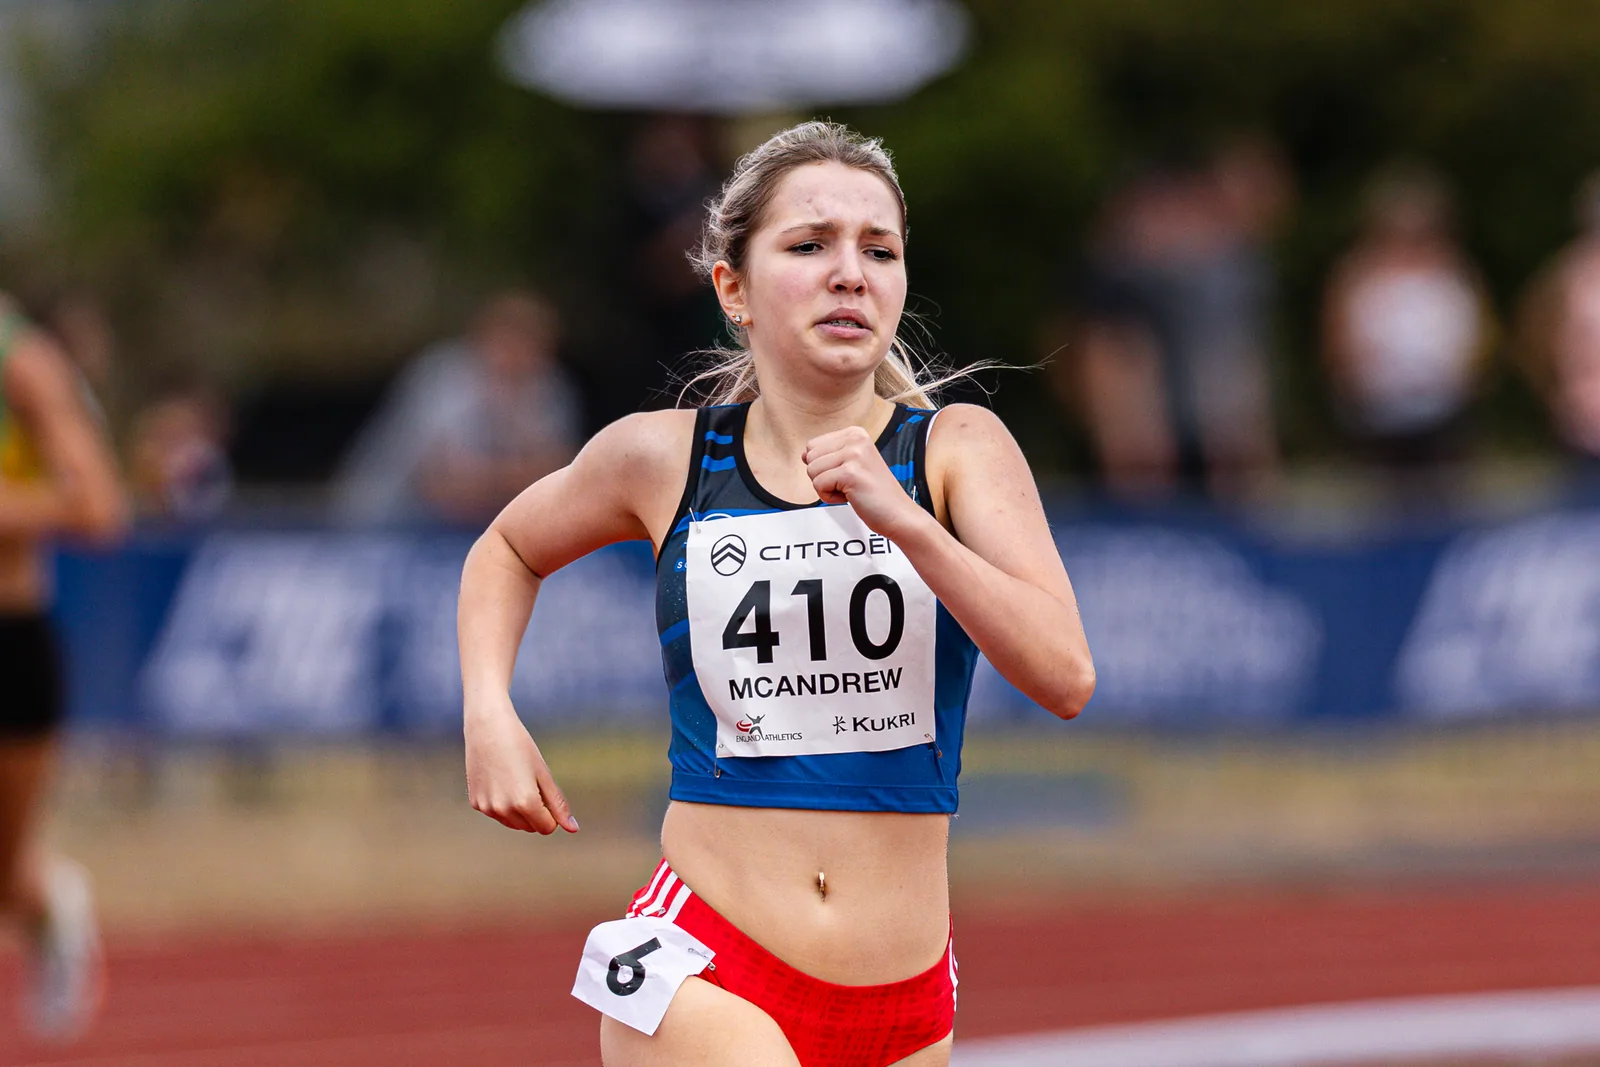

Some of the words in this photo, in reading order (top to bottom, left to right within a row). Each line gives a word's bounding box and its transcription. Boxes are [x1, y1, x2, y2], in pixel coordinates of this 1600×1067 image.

[759, 534, 892, 561] CITROË
[722, 573, 905, 664] 410
[728, 667, 903, 700] MCANDREW
[852, 712, 916, 732] KUKRI
[735, 734, 761, 743] ENGLAND
[764, 732, 803, 741] ATHLETICS
[606, 936, 662, 997] 6
